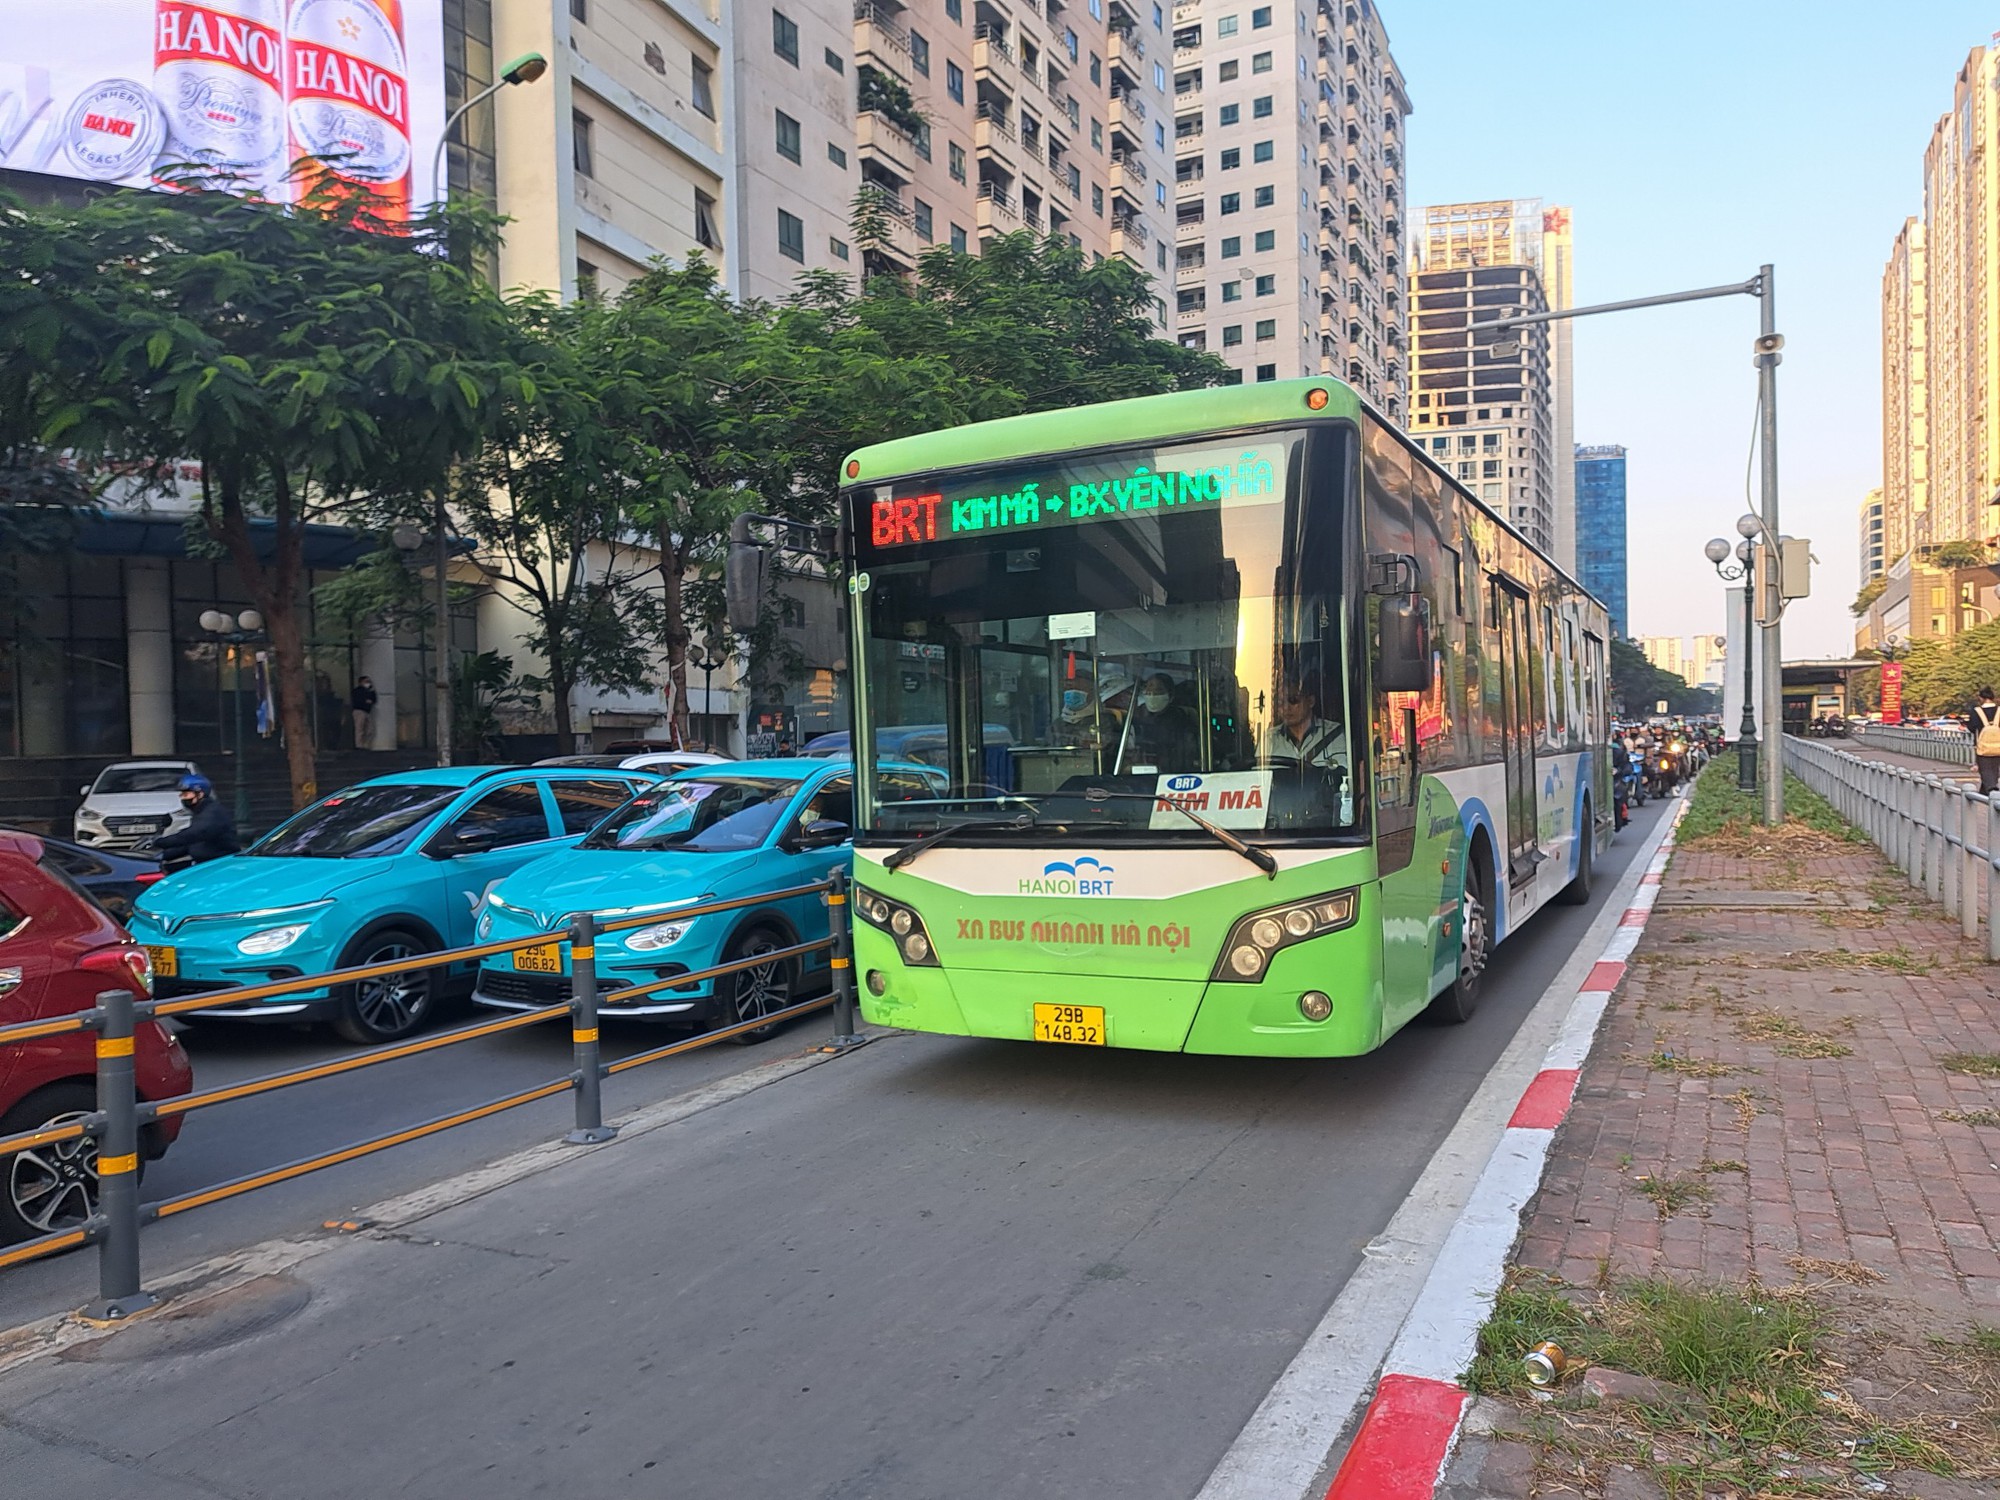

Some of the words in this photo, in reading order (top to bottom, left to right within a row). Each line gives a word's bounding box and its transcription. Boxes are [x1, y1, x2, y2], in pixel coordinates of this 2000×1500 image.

[158, 10, 282, 83] HANOI
[295, 49, 404, 125] HANOI
[94, 91, 144, 112] INHERIT
[82, 113, 136, 139] HANOI
[74, 140, 122, 164] LEGACY
[872, 493, 942, 546] BRT
[952, 496, 998, 532] KIM
[1001, 483, 1040, 526] MÃ
[1174, 777, 1197, 789] BRT
[1156, 791, 1210, 812] KIM
[1218, 785, 1263, 810] MÃ
[1018, 879, 1076, 895] HANOI
[1079, 880, 1114, 896] BRT
[989, 919, 1025, 941] BUS
[1031, 921, 1104, 945] NHANH
[1111, 920, 1141, 946] HÀ
[1147, 921, 1190, 954] NỘI
[518, 956, 556, 971] 006.82
[1053, 1007, 1083, 1023] 29B
[1043, 1024, 1097, 1043] 148.32
